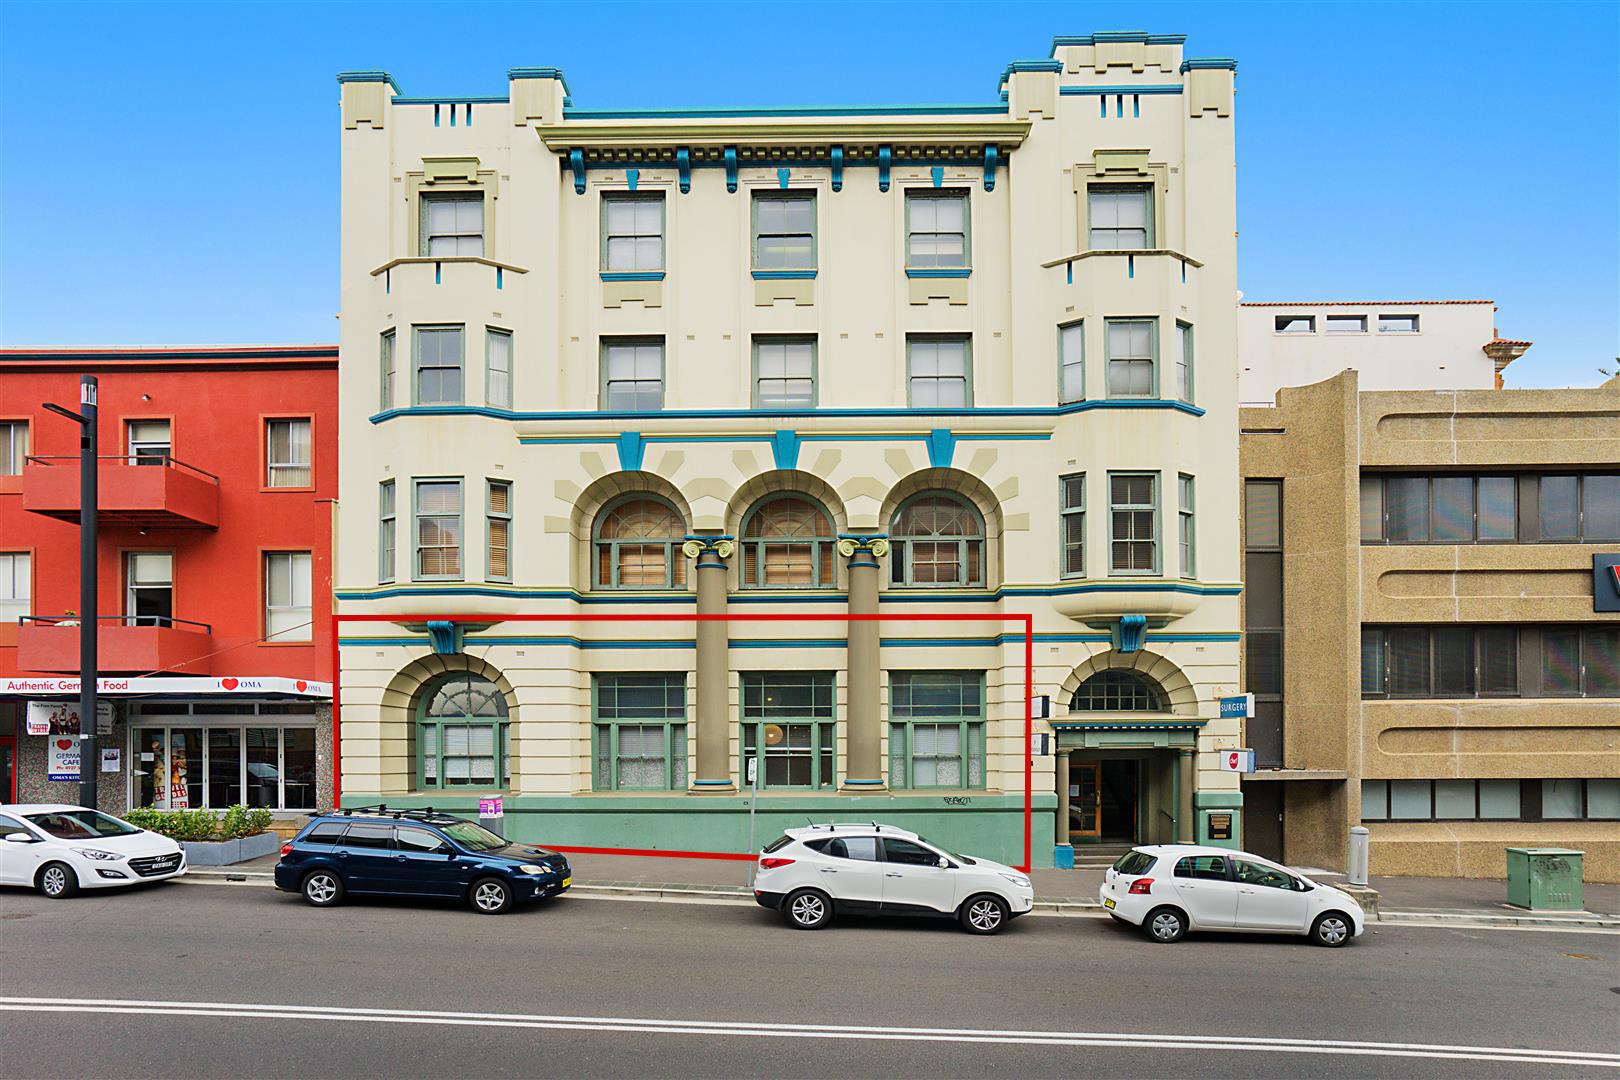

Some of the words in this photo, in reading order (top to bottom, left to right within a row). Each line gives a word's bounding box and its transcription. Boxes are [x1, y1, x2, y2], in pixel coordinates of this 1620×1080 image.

[7, 681, 54, 690] Authentic
[103, 680, 128, 690] Food
[308, 685, 322, 693] OMA
[1220, 703, 1247, 712] SURGERY
